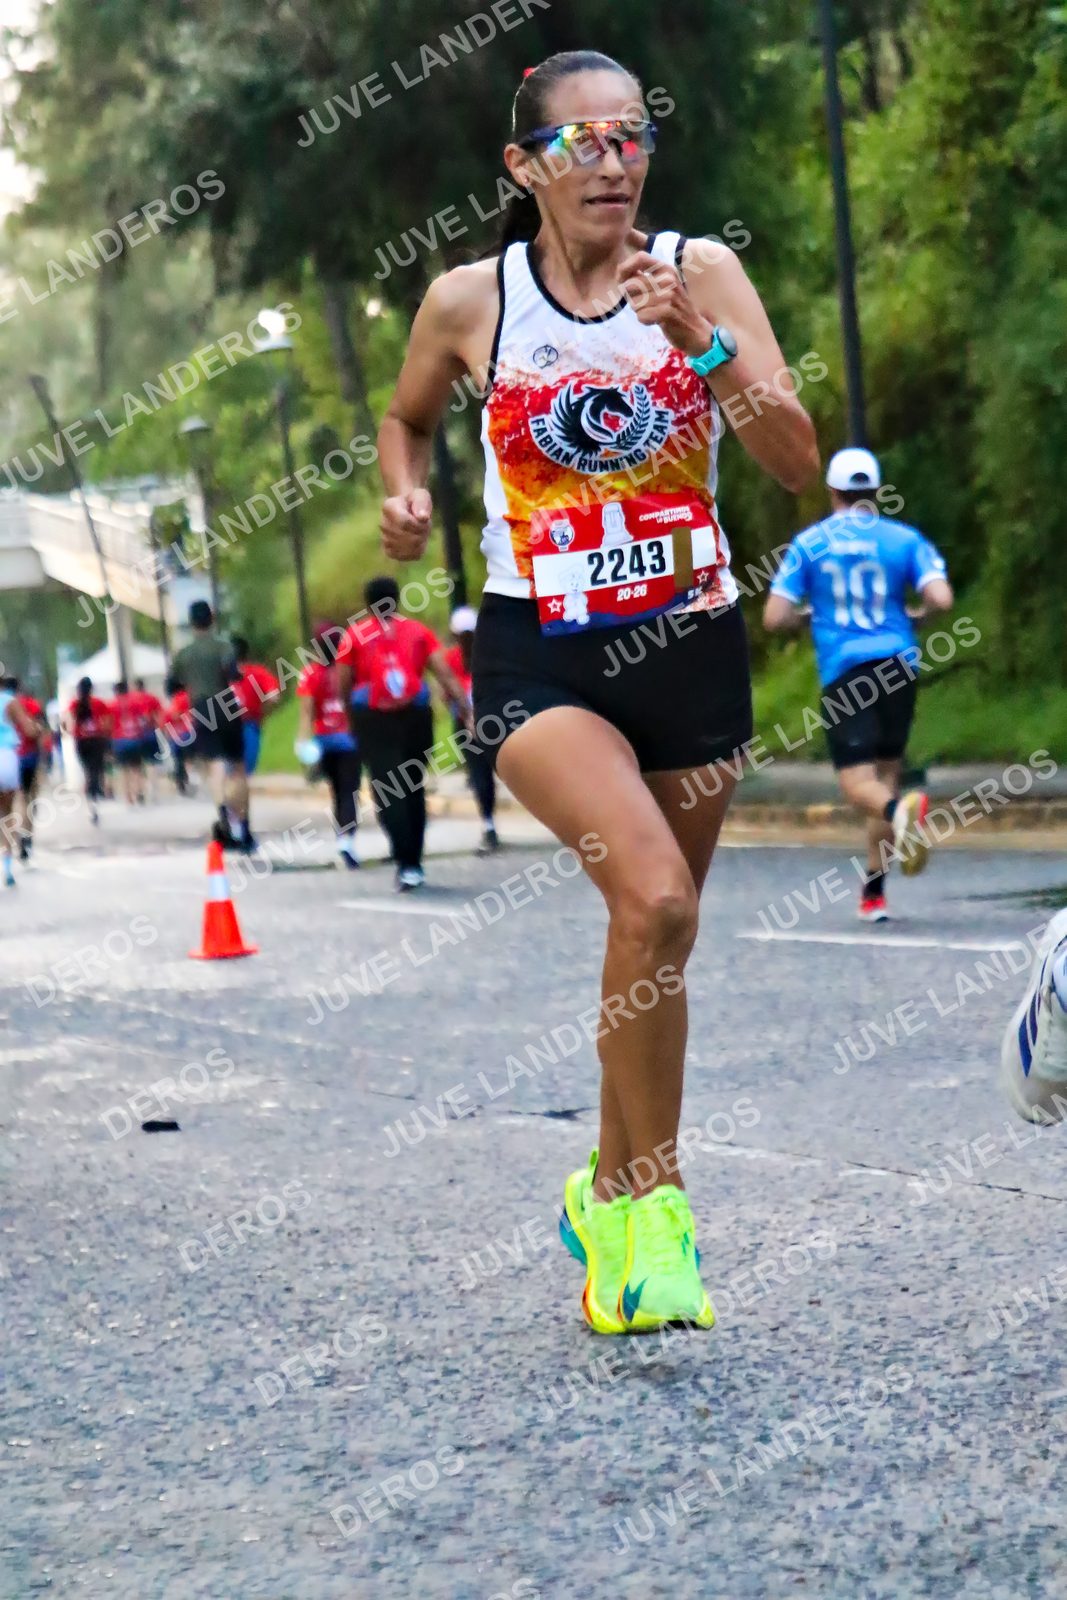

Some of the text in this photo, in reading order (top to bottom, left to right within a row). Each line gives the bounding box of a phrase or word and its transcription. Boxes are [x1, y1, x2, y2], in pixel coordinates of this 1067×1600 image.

[530, 409, 670, 473] FABIAN RUNNING TEAM
[587, 540, 667, 587] 2243
[616, 584, 647, 602] 20-26
[821, 560, 887, 629] 10
